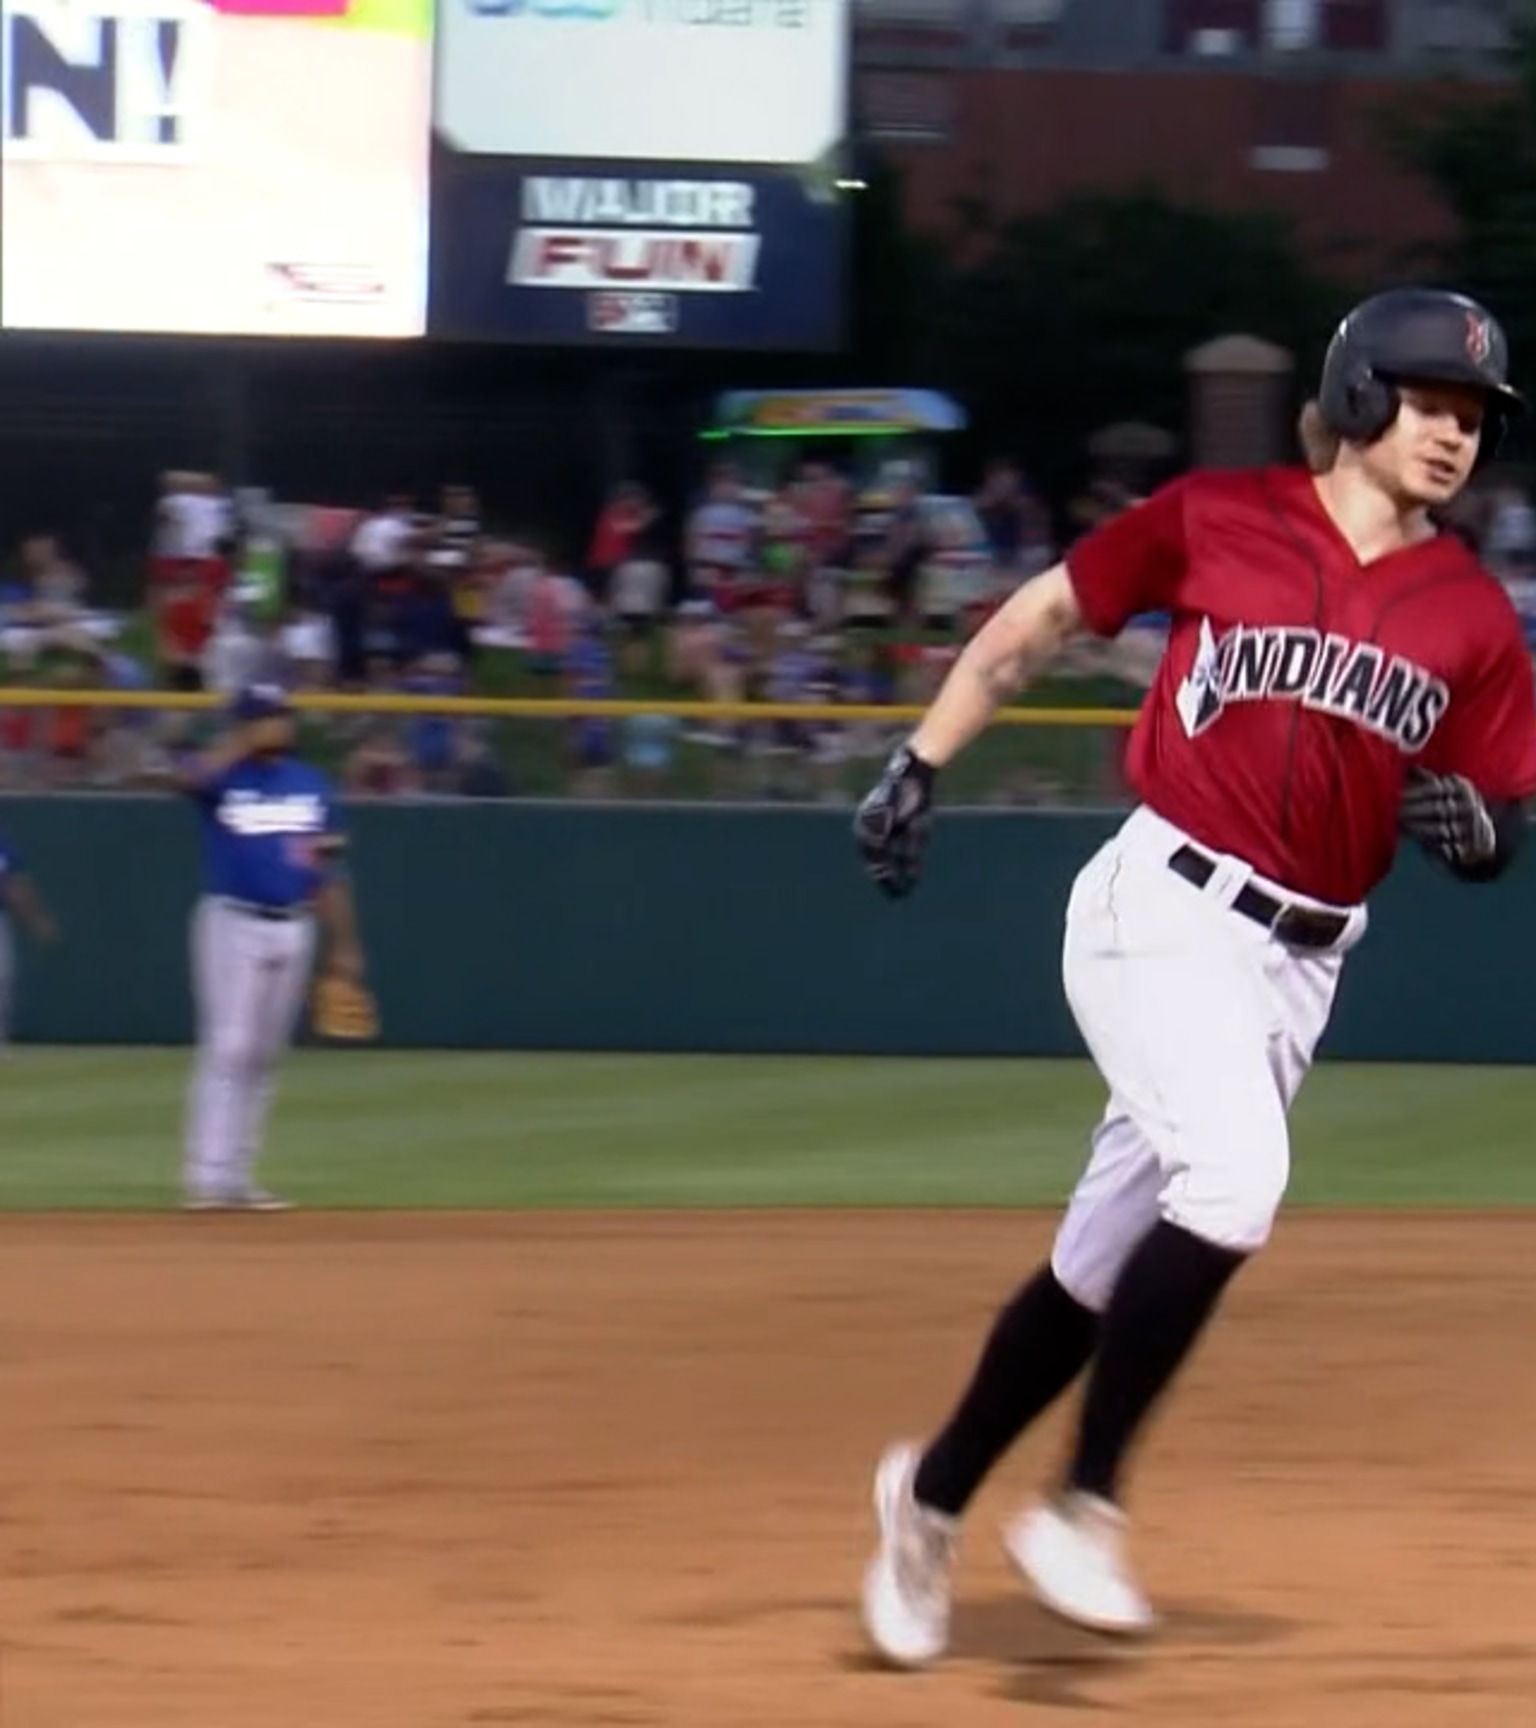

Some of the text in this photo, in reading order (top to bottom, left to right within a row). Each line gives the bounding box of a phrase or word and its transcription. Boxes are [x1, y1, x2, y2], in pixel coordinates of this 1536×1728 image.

[520, 176, 756, 226] MAJOR
[533, 235, 737, 283] FUN
[1204, 620, 1450, 754] INDIANS
